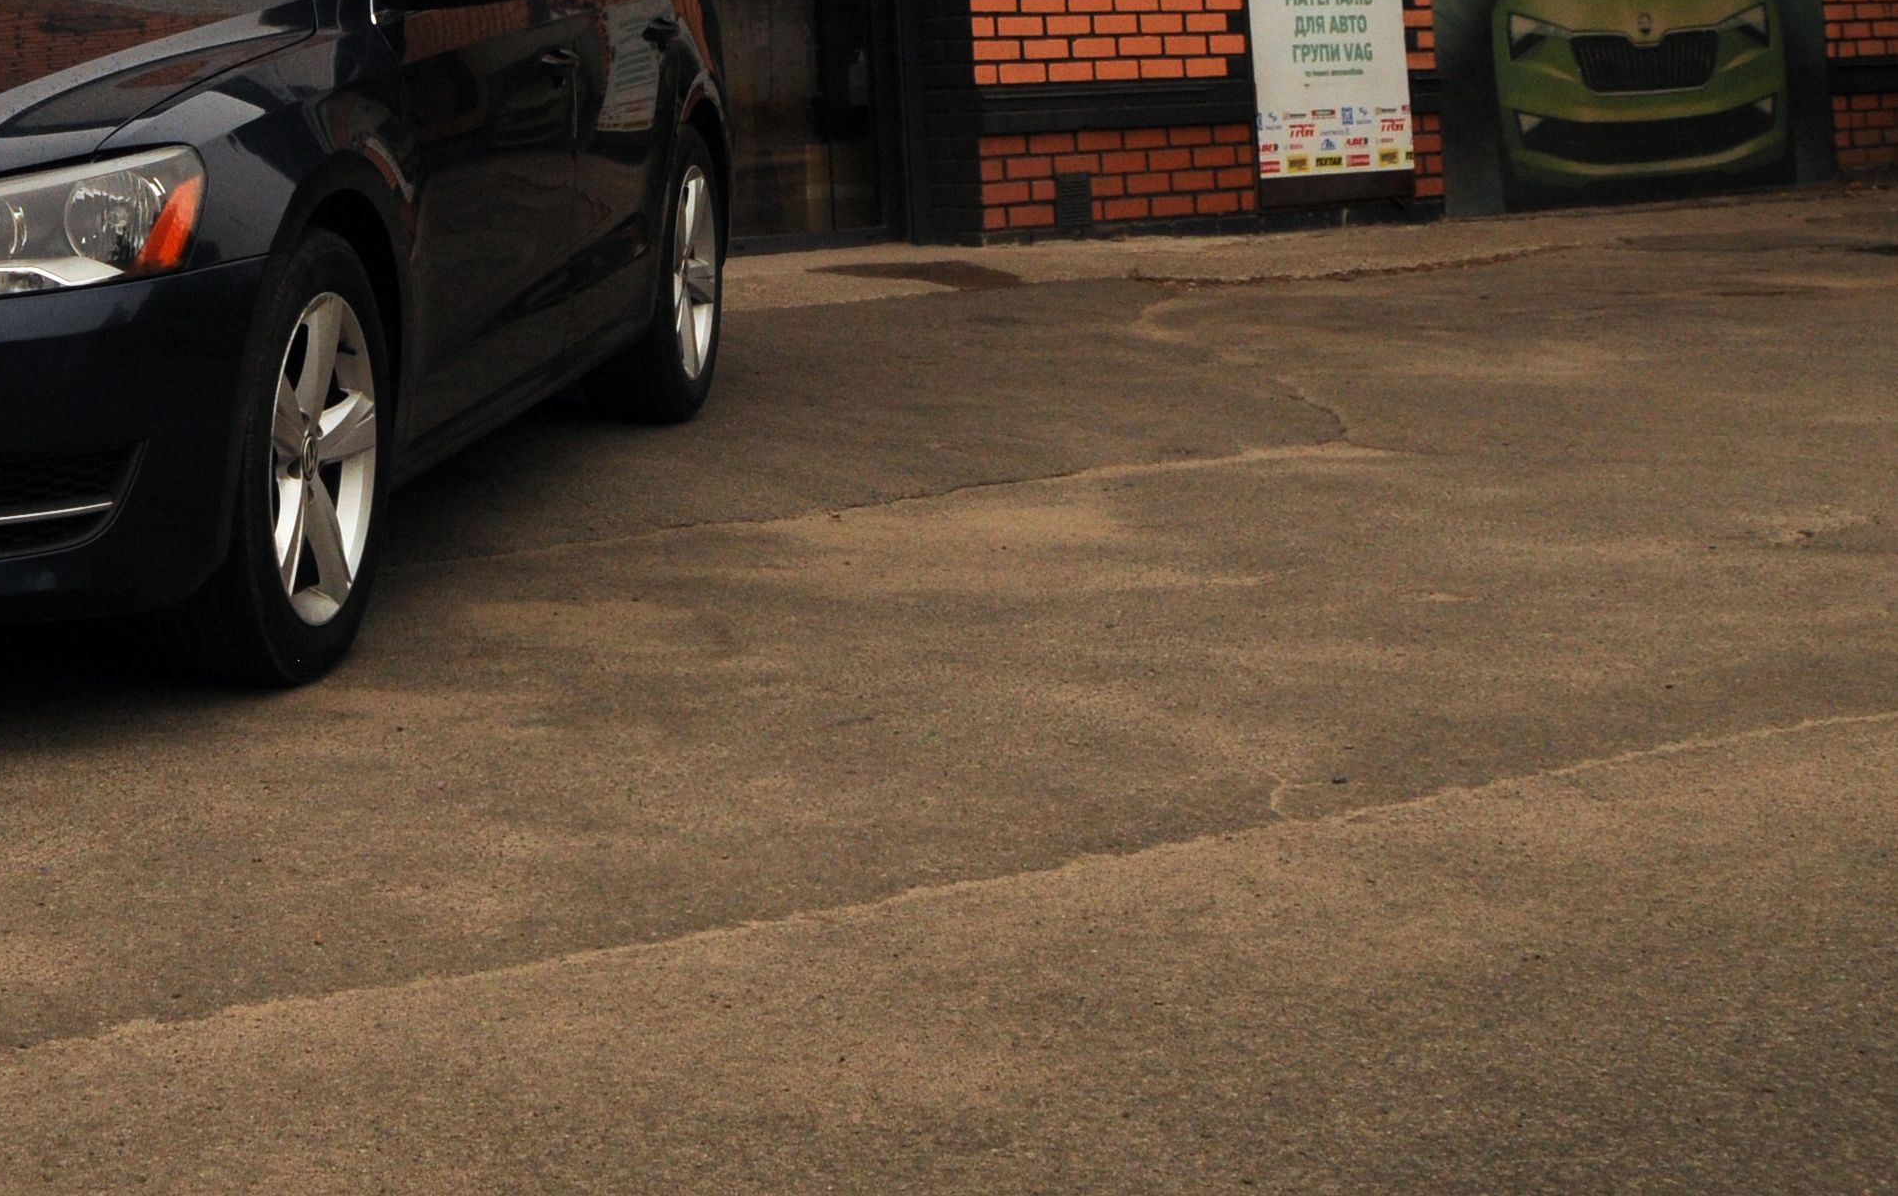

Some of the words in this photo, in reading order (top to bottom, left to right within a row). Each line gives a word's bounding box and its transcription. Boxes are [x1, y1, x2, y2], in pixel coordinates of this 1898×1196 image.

[1294, 15, 1325, 37] ДЛЯ
[1330, 14, 1367, 33] АВТО
[1292, 44, 1340, 63] ГРУПИ
[1343, 42, 1373, 62] VAG
